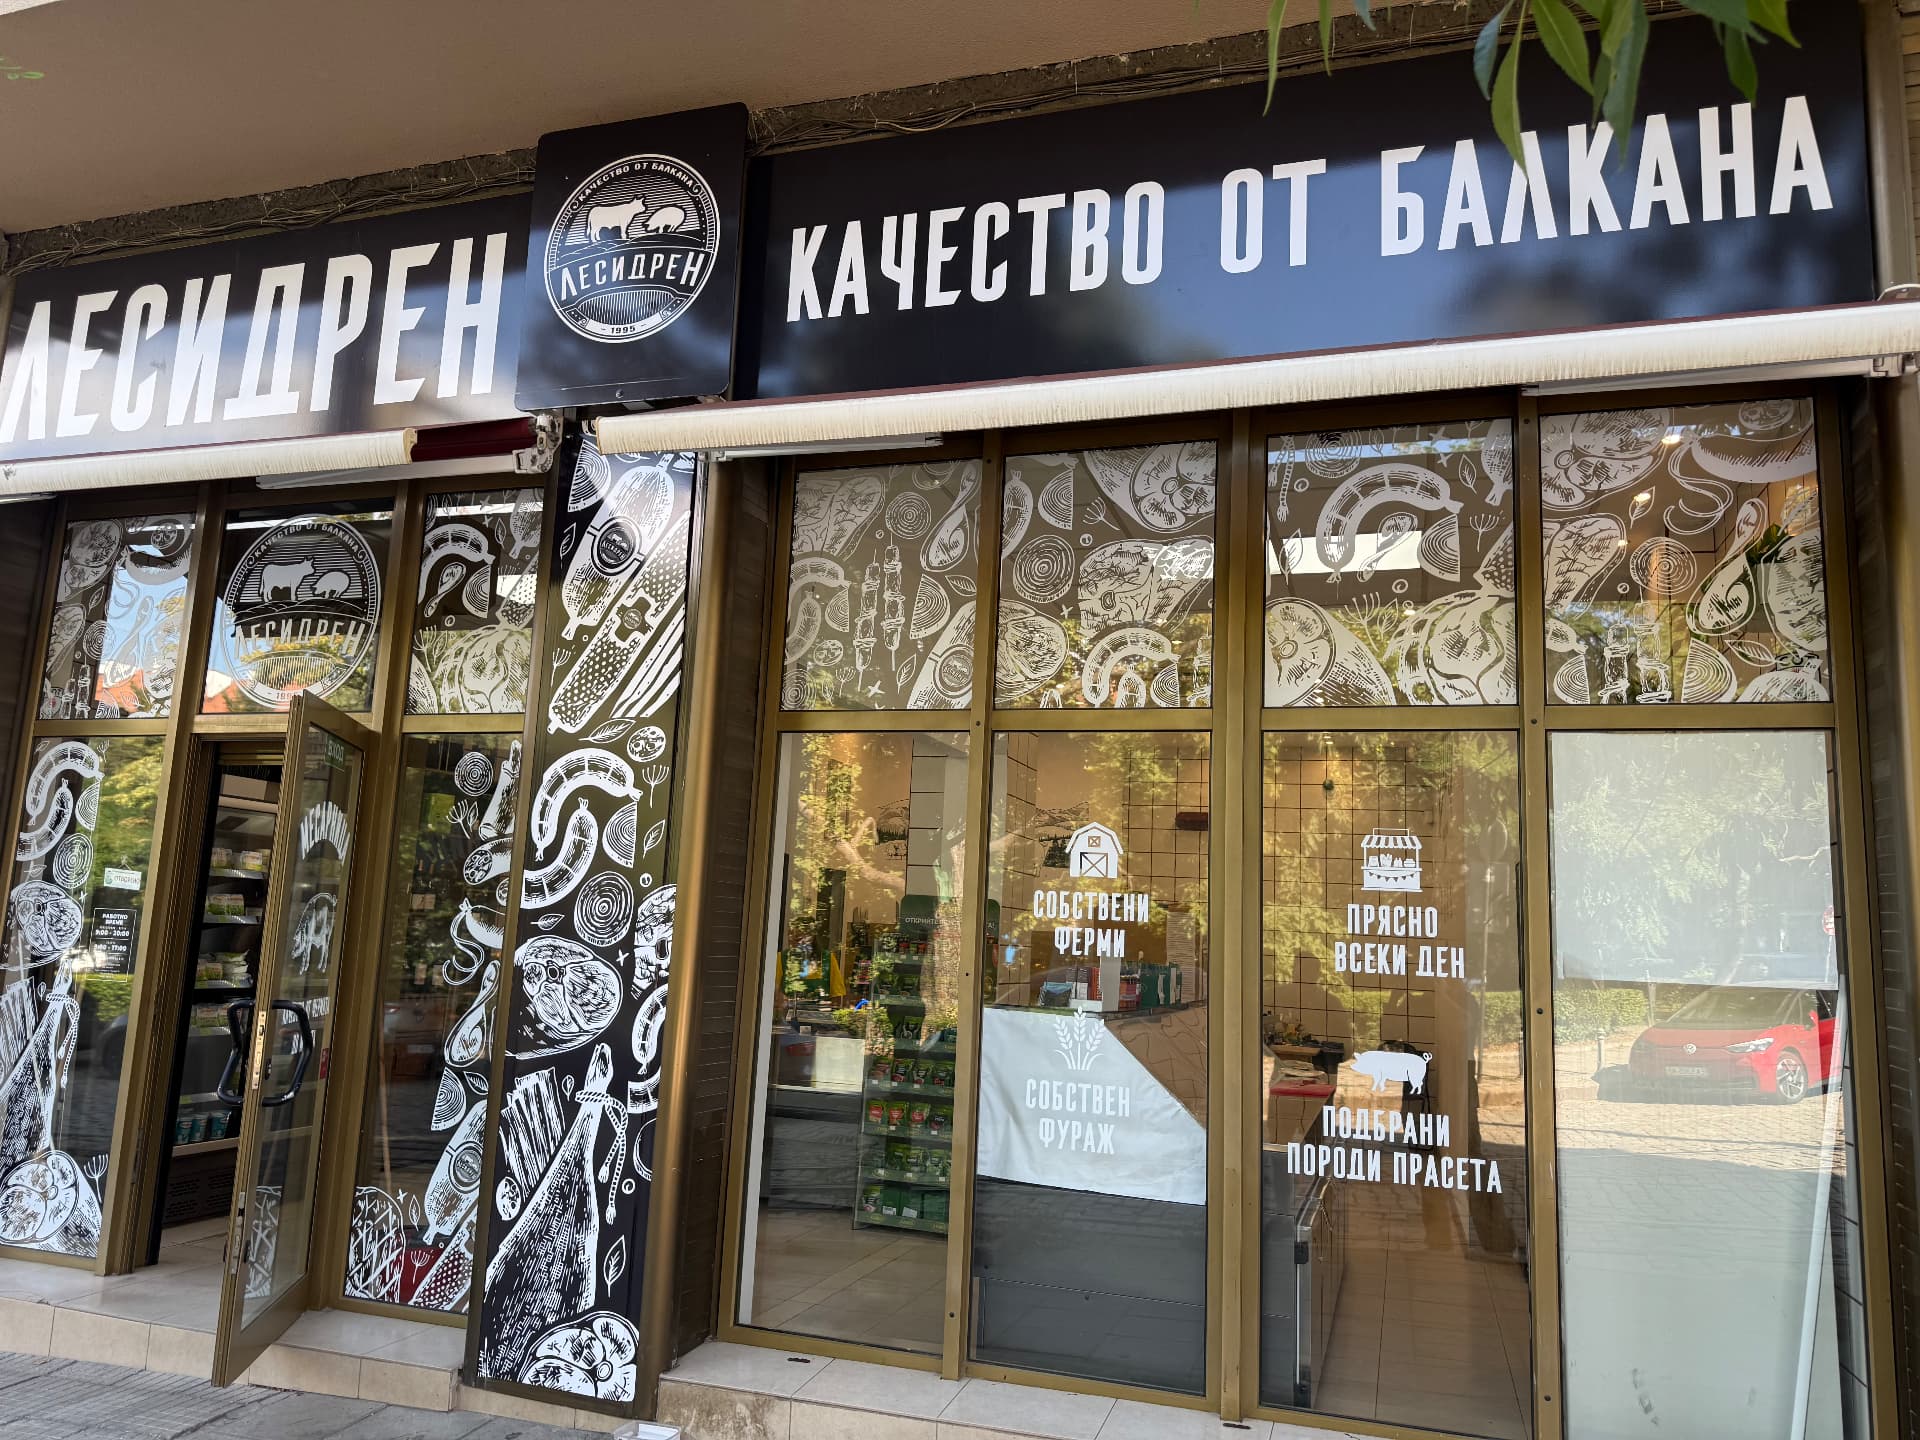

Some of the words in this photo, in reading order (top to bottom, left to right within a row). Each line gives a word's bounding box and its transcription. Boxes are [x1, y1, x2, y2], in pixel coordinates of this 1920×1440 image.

[578, 165, 630, 202] КАЧЕСТВО
[634, 162, 649, 171] ОТ
[651, 162, 694, 188] БАЛКАНА
[786, 182, 1165, 323] КАЧЕСТВО
[1220, 158, 1327, 274] ОТ
[1380, 95, 1834, 257] БАЛКАНА
[560, 251, 705, 301] ЛЕСИДРЕН
[0, 231, 508, 444] ЛЕСИДРЕН
[610, 325, 636, 335] 1995
[254, 526, 302, 558] КАЧЕСТВО
[321, 523, 359, 553] БАЛКАНА
[234, 617, 367, 660] ЛЕСИДРЕН
[1033, 889, 1149, 923] СОБСТВЕНИ
[1347, 903, 1438, 938] ПРЯСНО
[1054, 924, 1126, 959] ФЕРМИ
[1334, 941, 1406, 976] ВСЕКИ
[1415, 945, 1465, 979] ДЕН
[1025, 1078, 1130, 1118] СОБСТВЕН
[1039, 1117, 1115, 1155] ФУРАЖ
[1322, 1105, 1450, 1148] ПОДБРАНИ
[1286, 1142, 1381, 1182] ПОРОДИ
[1393, 1151, 1503, 1194] ПРАСЕТА
